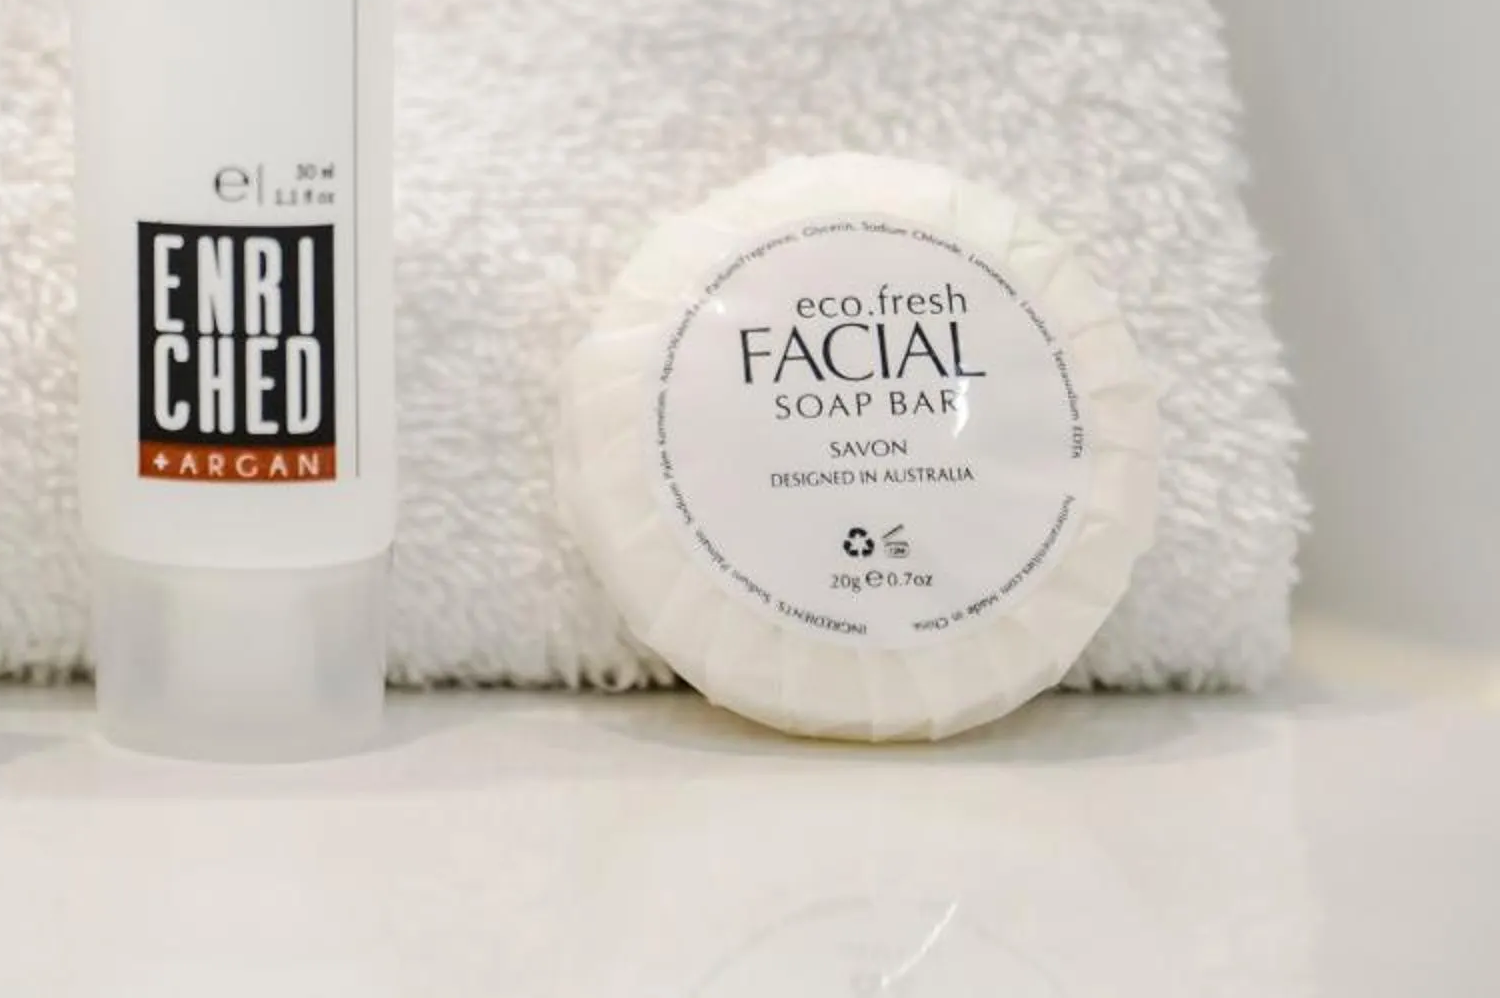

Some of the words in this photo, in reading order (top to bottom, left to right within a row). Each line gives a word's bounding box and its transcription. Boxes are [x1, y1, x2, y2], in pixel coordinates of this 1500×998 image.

[797, 283, 966, 318] eco.fresh
[740, 321, 986, 383] FACIAL
[776, 392, 872, 419] SOAP
[890, 390, 955, 415] BAR
[830, 440, 907, 458] SAVON
[771, 471, 855, 487] DESIGNED
[860, 470, 877, 484] IN
[884, 467, 974, 482] AUSTRALIA
